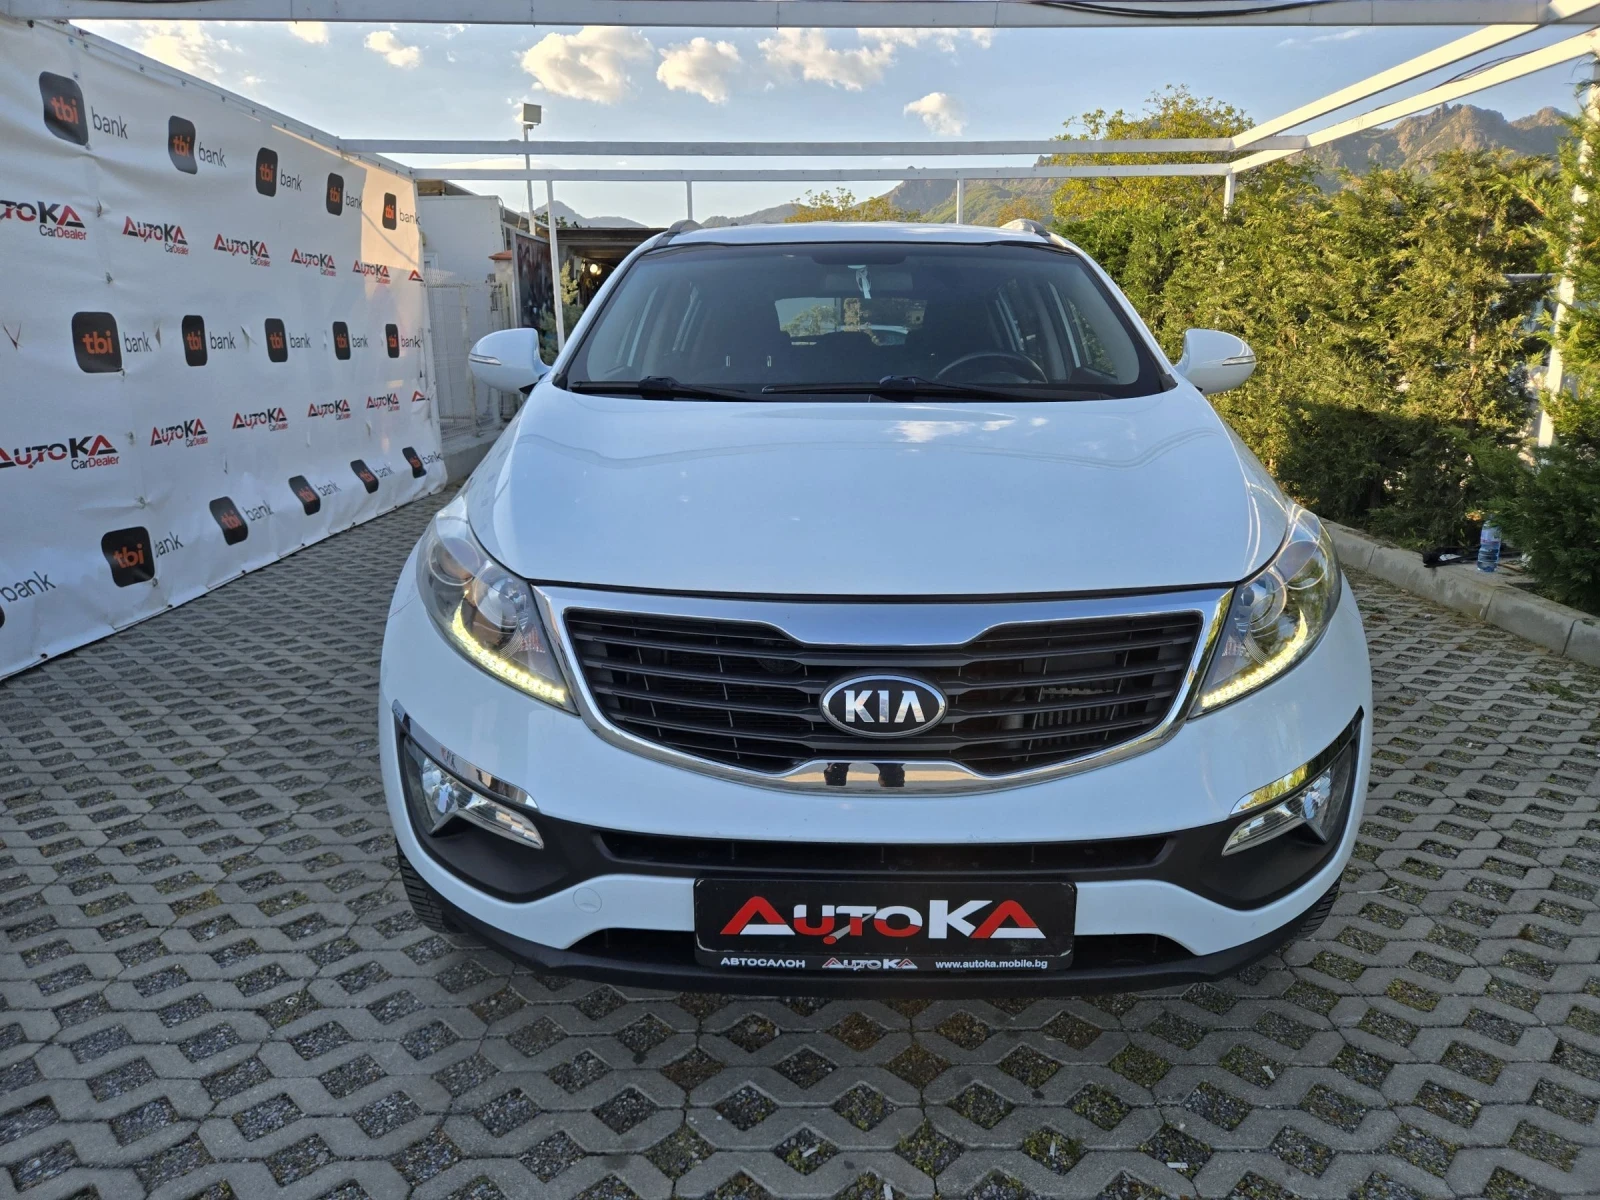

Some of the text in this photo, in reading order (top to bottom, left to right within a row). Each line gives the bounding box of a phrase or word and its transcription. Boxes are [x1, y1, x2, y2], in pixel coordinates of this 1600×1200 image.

[51, 97, 128, 139] tbi bank
[173, 136, 227, 168] tbi bank
[260, 163, 302, 192] tbi bank
[330, 187, 363, 209] tbi bank
[385, 205, 421, 226] tbi bank
[39, 224, 87, 240] CarDealer
[82, 330, 152, 355] tbi bank
[187, 331, 236, 350] tbi bank
[270, 332, 311, 349] tbi bank
[337, 334, 369, 349] tbi bank
[388, 335, 421, 348] tbi bank
[71, 455, 120, 470] CarDealer
[314, 480, 342, 497] bank
[221, 500, 275, 529] tbi bank
[113, 543, 145, 569] tbi
[844, 690, 926, 723] KIA
[720, 956, 806, 969] АВТОСАЛОН
[935, 959, 1049, 971] www.autoka.mobile.bg
